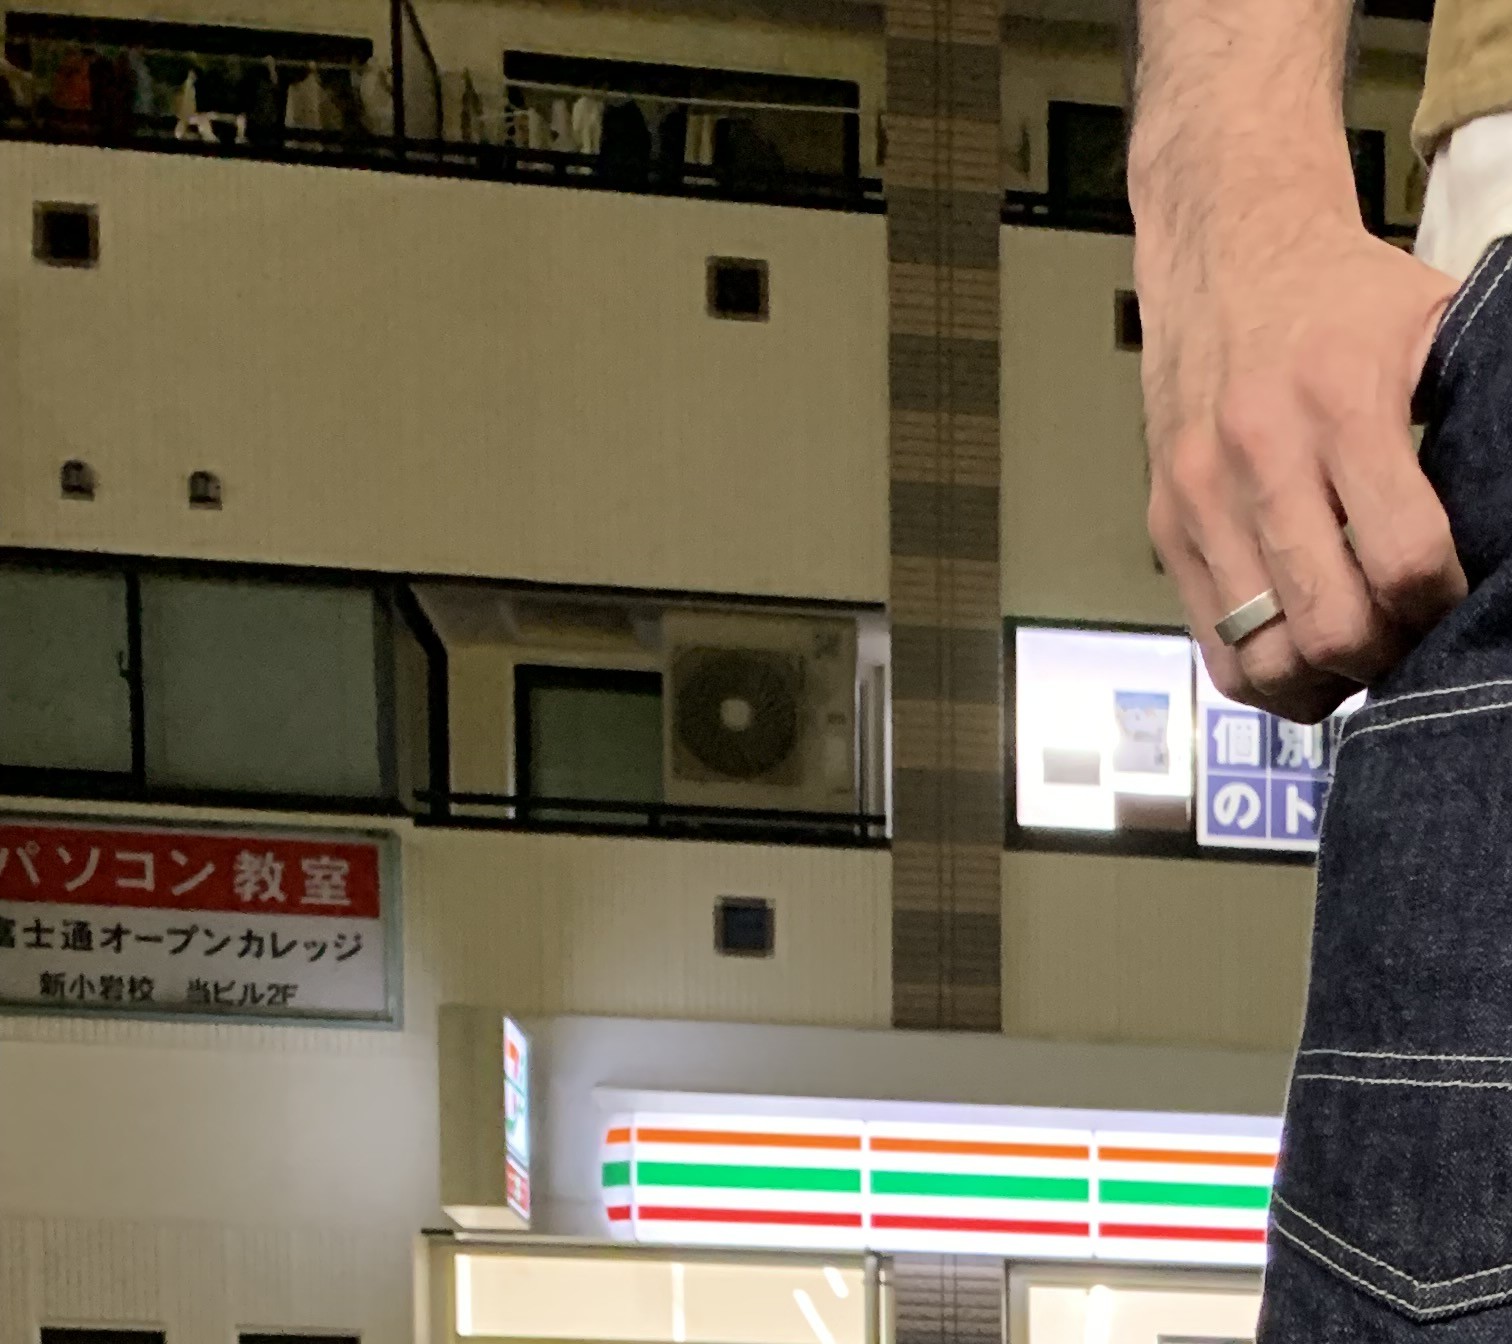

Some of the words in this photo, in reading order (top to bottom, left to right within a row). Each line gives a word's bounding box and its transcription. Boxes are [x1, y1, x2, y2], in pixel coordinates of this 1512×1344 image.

[1213, 782, 1317, 834] のト
[0, 840, 352, 906] パソコン教室
